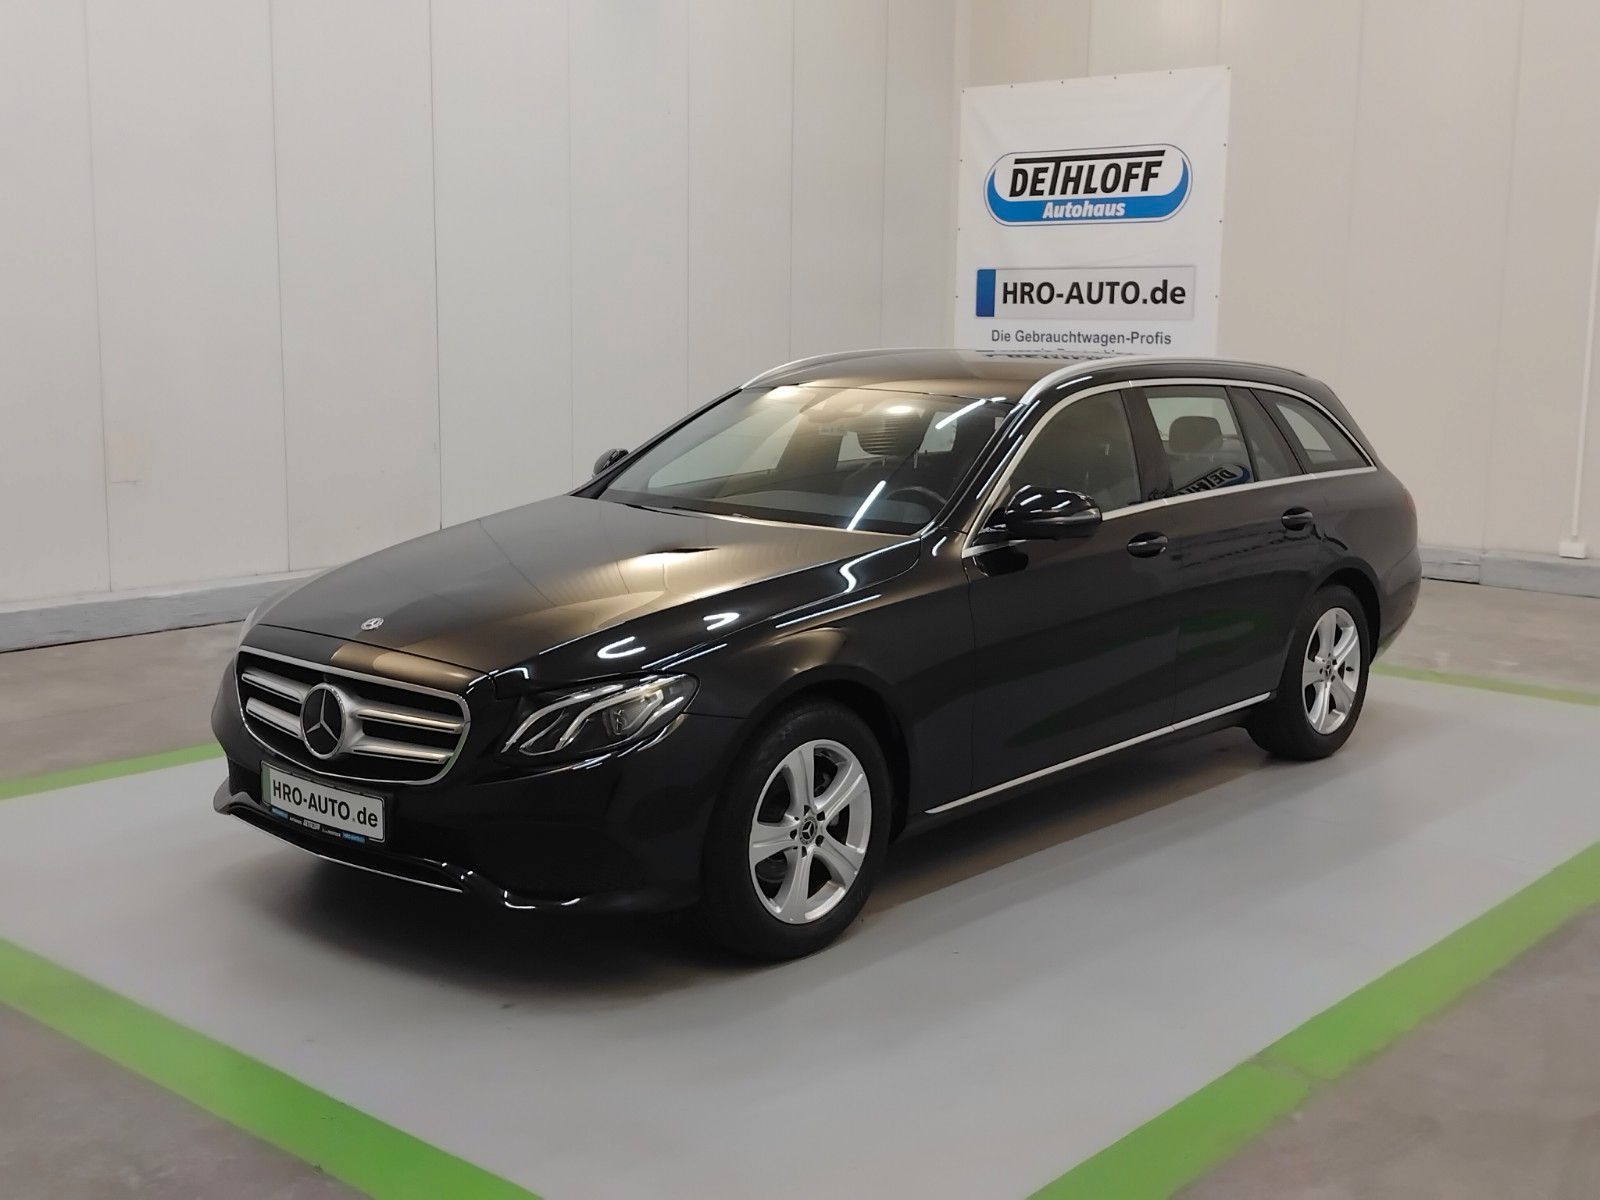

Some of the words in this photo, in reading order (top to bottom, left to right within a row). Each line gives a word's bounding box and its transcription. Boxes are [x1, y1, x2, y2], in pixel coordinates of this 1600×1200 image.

[1009, 150, 1165, 198] DETHLOFF
[1042, 200, 1126, 219] Autohaus
[1002, 279, 1186, 305] HRO-AUTO.de
[991, 330, 1011, 343] Die
[1015, 330, 1172, 347] Gebrauchtwagen-Profis
[272, 779, 378, 828] HRO-AUTO.de
